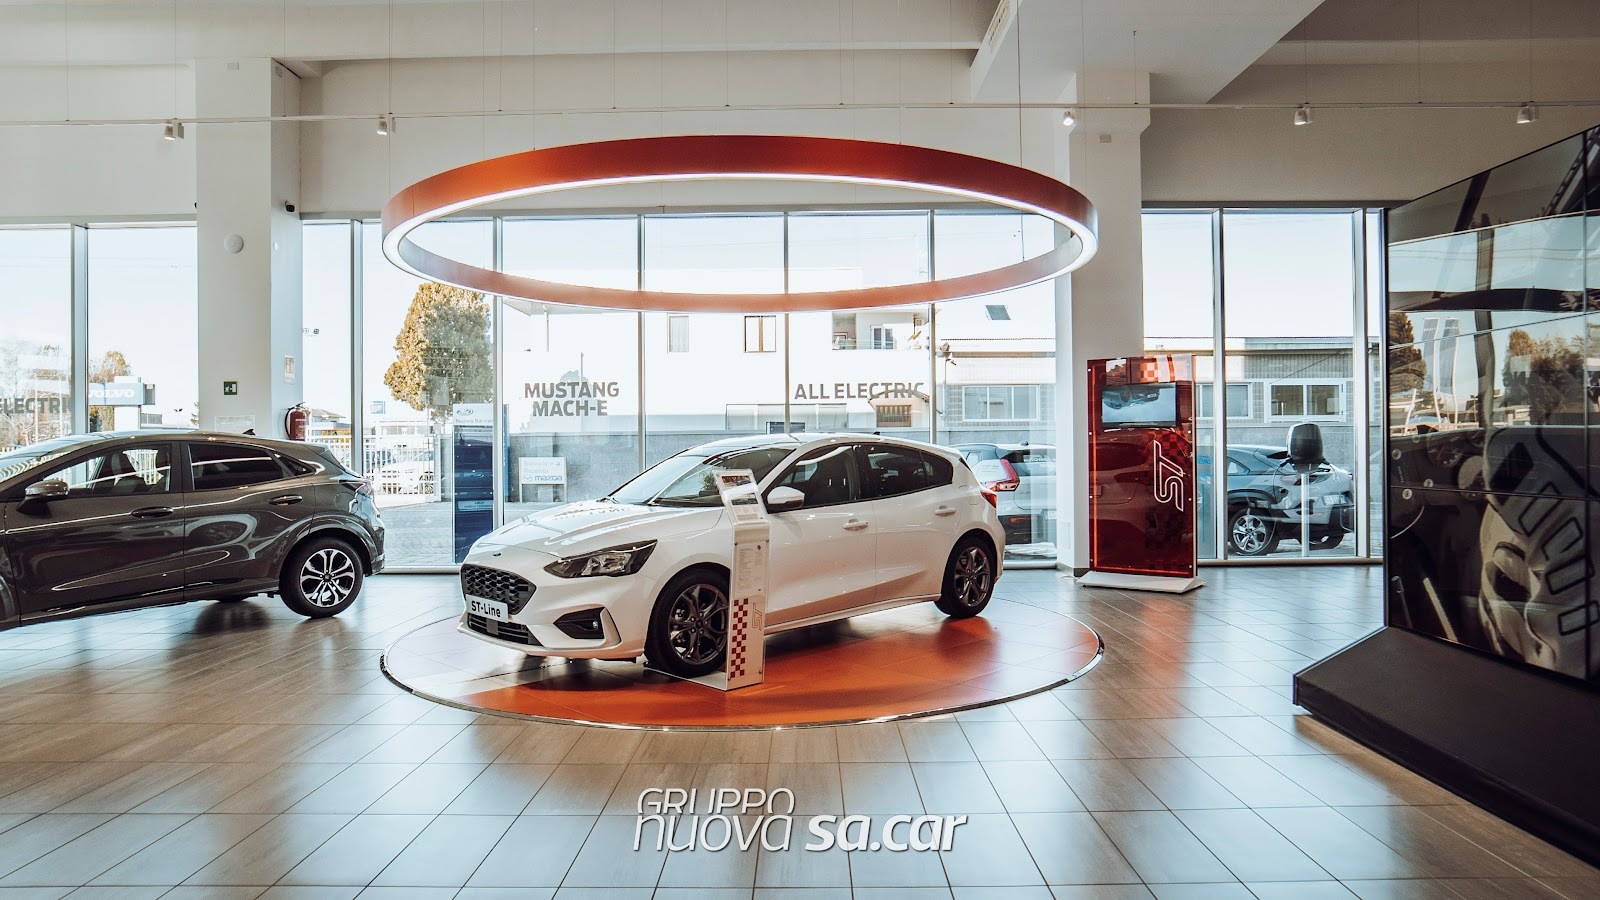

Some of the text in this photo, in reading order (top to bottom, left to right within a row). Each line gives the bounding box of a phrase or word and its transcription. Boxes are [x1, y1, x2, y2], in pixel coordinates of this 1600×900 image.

[524, 382, 620, 398] MUSTANG
[794, 382, 924, 399] ALL ELECTRIC
[532, 400, 608, 416] MACH-E
[471, 600, 501, 618] ST-Line
